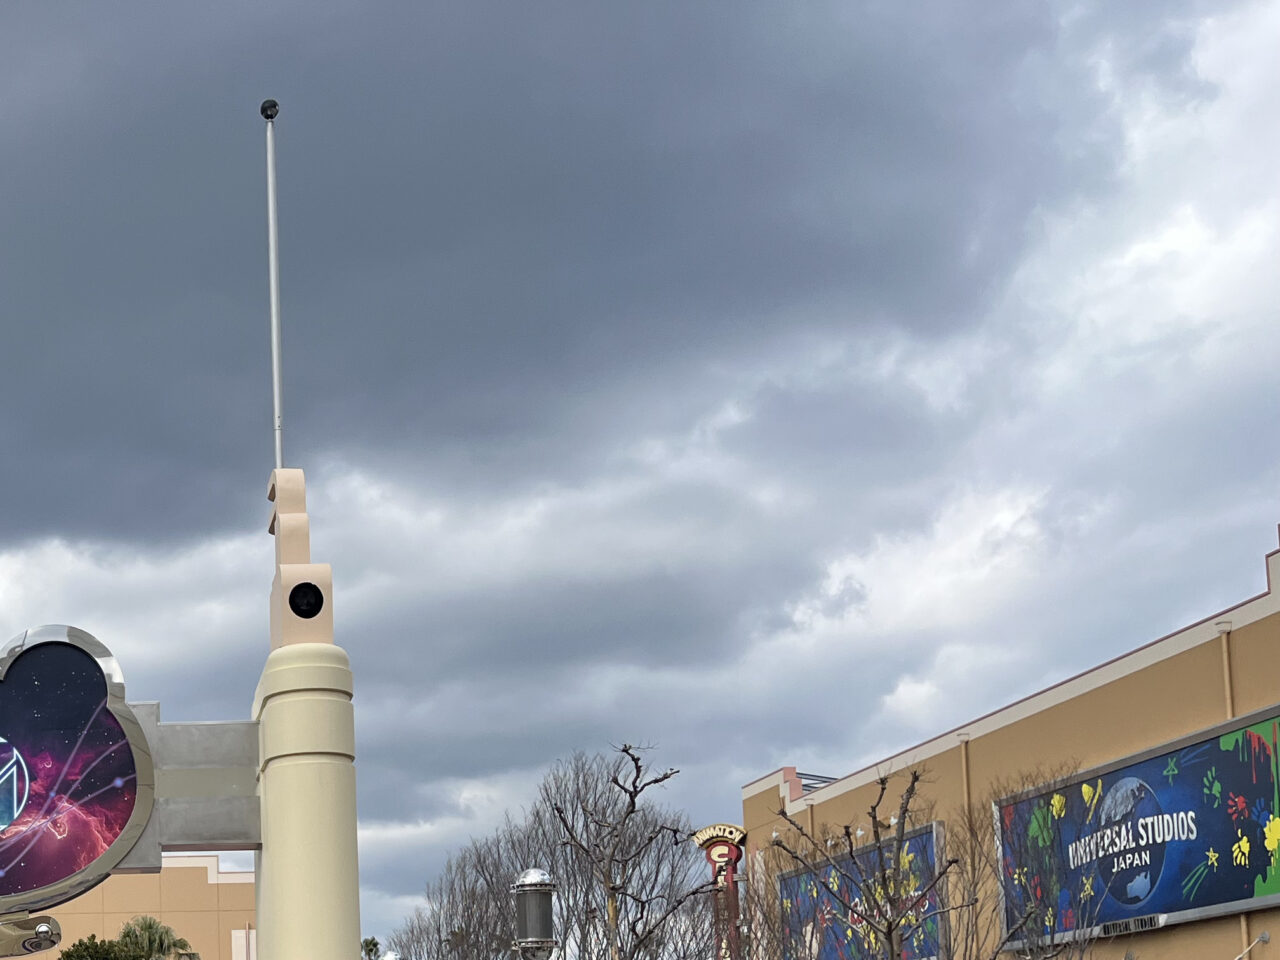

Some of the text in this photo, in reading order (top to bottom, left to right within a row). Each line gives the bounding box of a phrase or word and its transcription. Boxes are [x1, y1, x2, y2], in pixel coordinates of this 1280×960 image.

[694, 825, 744, 848] ANIMATION
[1068, 810, 1198, 870] UNIVERSAL STUDIOS
[1112, 850, 1151, 873] JAPAN
